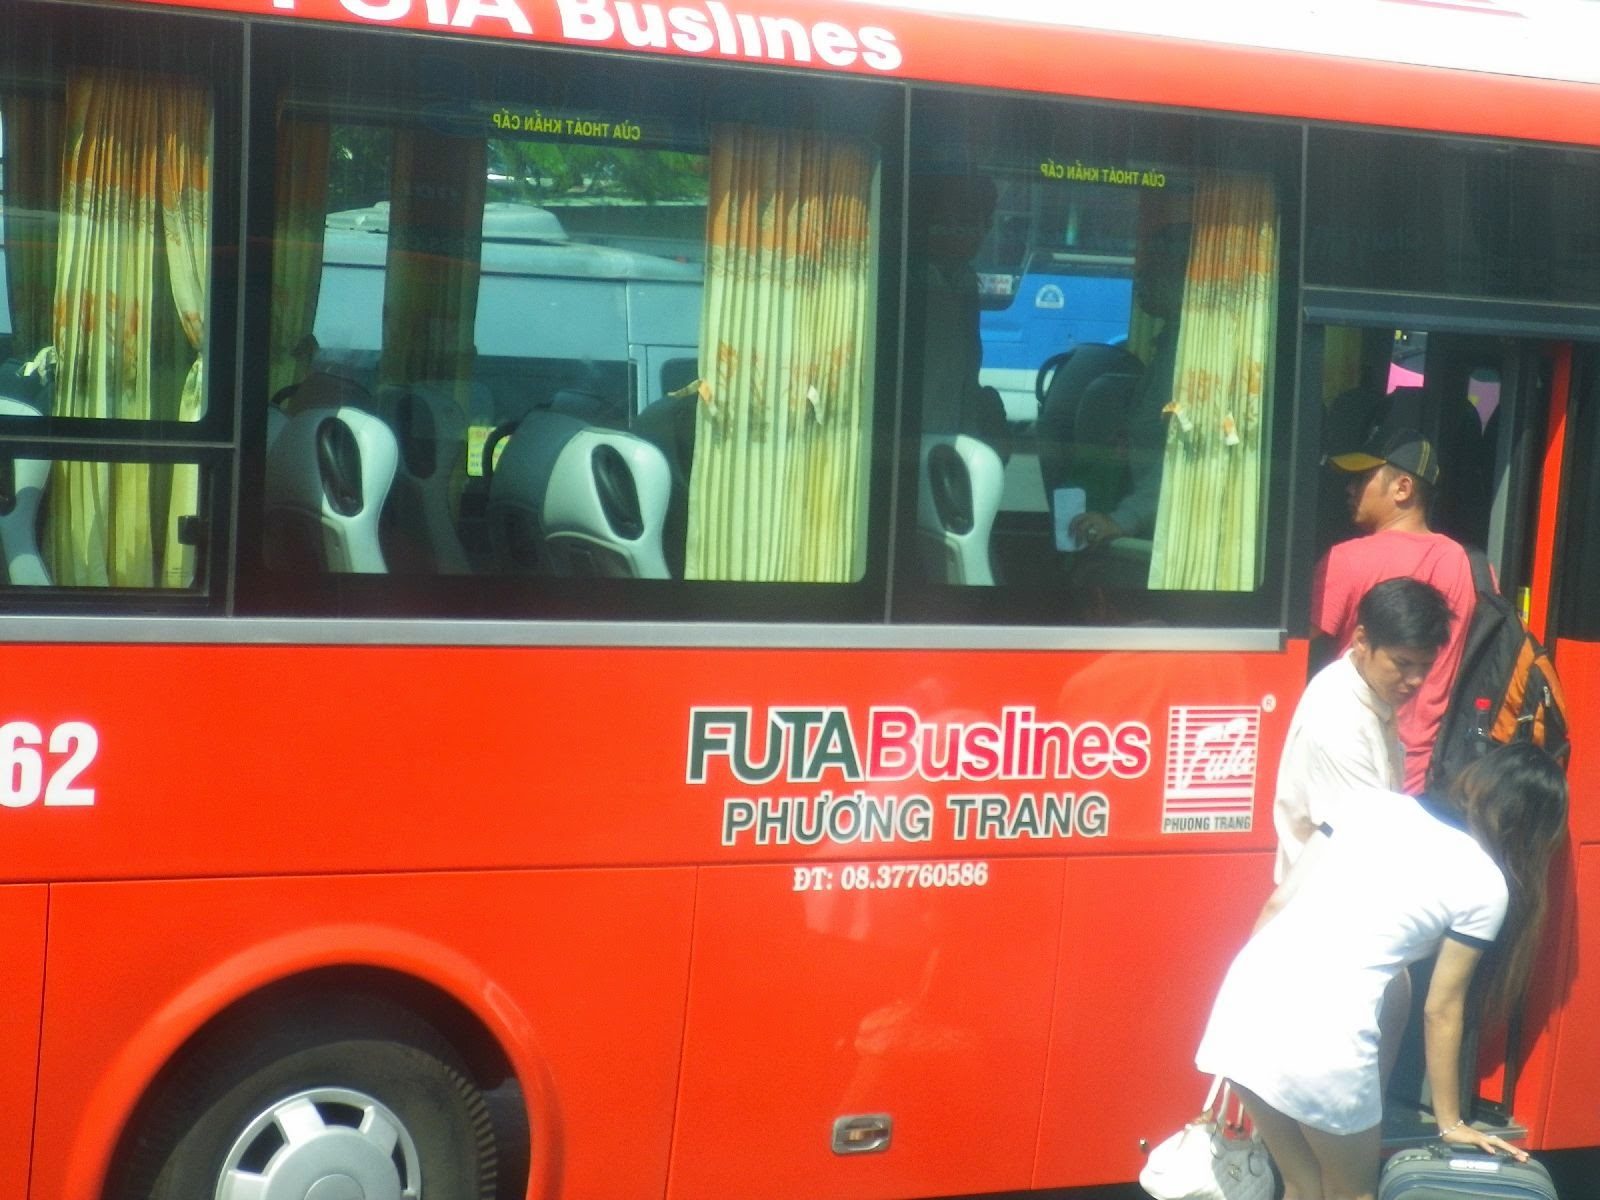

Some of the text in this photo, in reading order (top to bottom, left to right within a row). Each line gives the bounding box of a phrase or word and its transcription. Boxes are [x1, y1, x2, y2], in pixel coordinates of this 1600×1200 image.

[556, 0, 903, 71] Buslines
[0, 721, 99, 808] 62
[685, 705, 1151, 785] FUTA Buslines
[721, 790, 1110, 846] PHƯƠNG TRANG
[1214, 815, 1251, 829] TRANG
[793, 862, 989, 891] ĐT: 08.37760586
